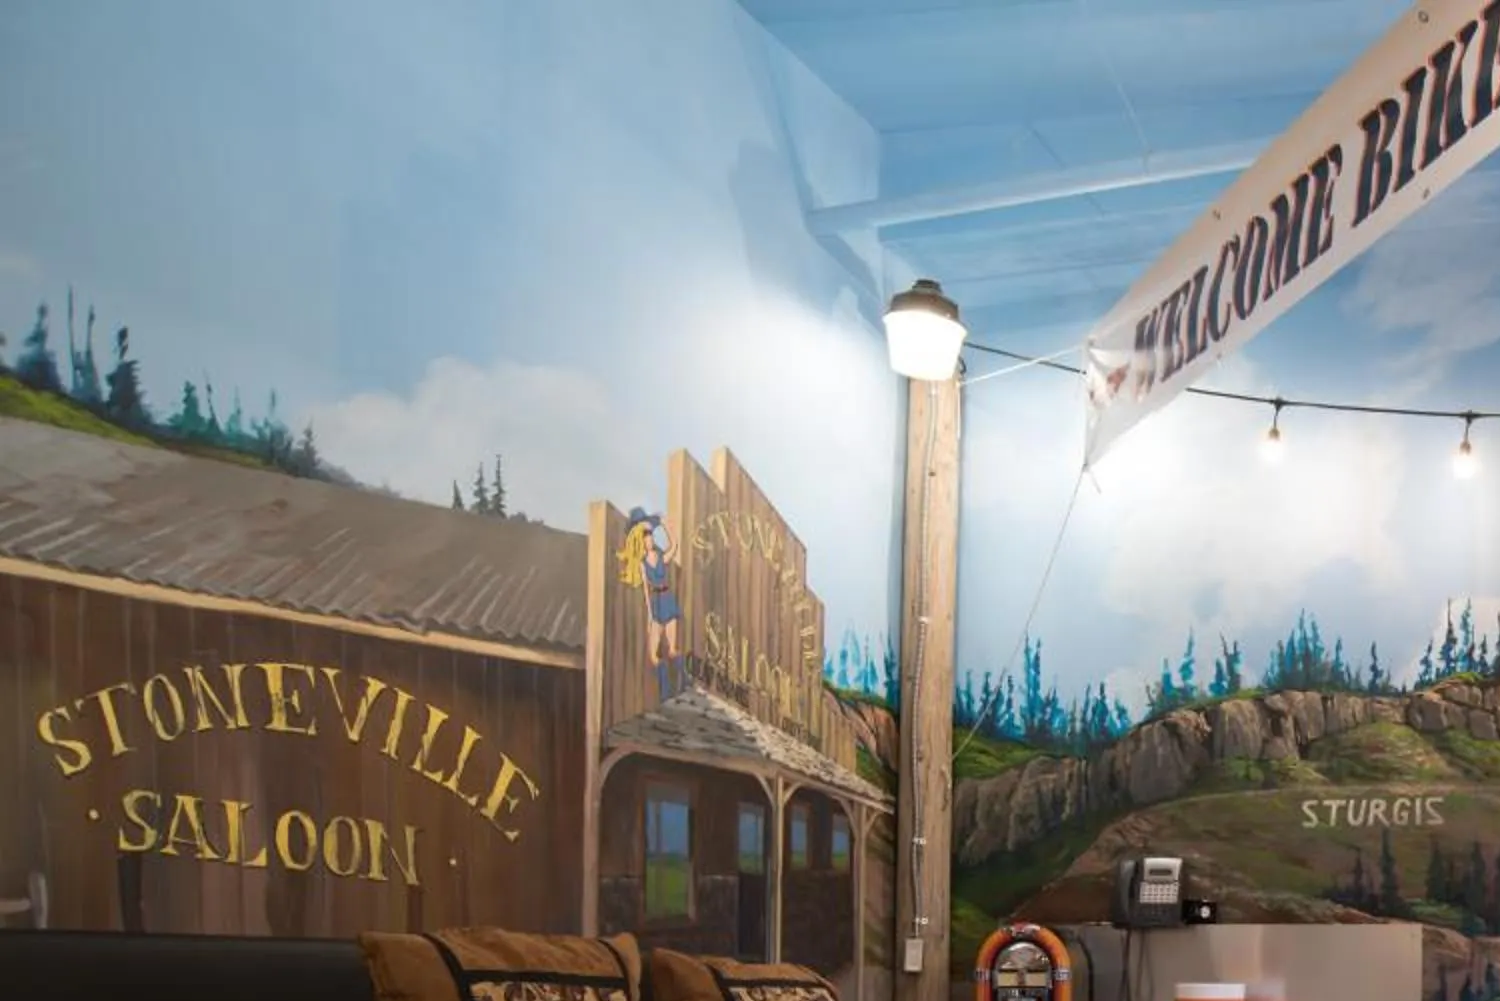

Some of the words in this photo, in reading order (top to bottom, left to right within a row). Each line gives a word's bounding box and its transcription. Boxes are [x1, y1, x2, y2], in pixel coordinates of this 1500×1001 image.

[1134, 143, 1343, 398] WELCOME
[37, 662, 540, 842] STONEVILLE
[1301, 797, 1445, 828] STURGIS
[117, 790, 420, 886] SALOON
